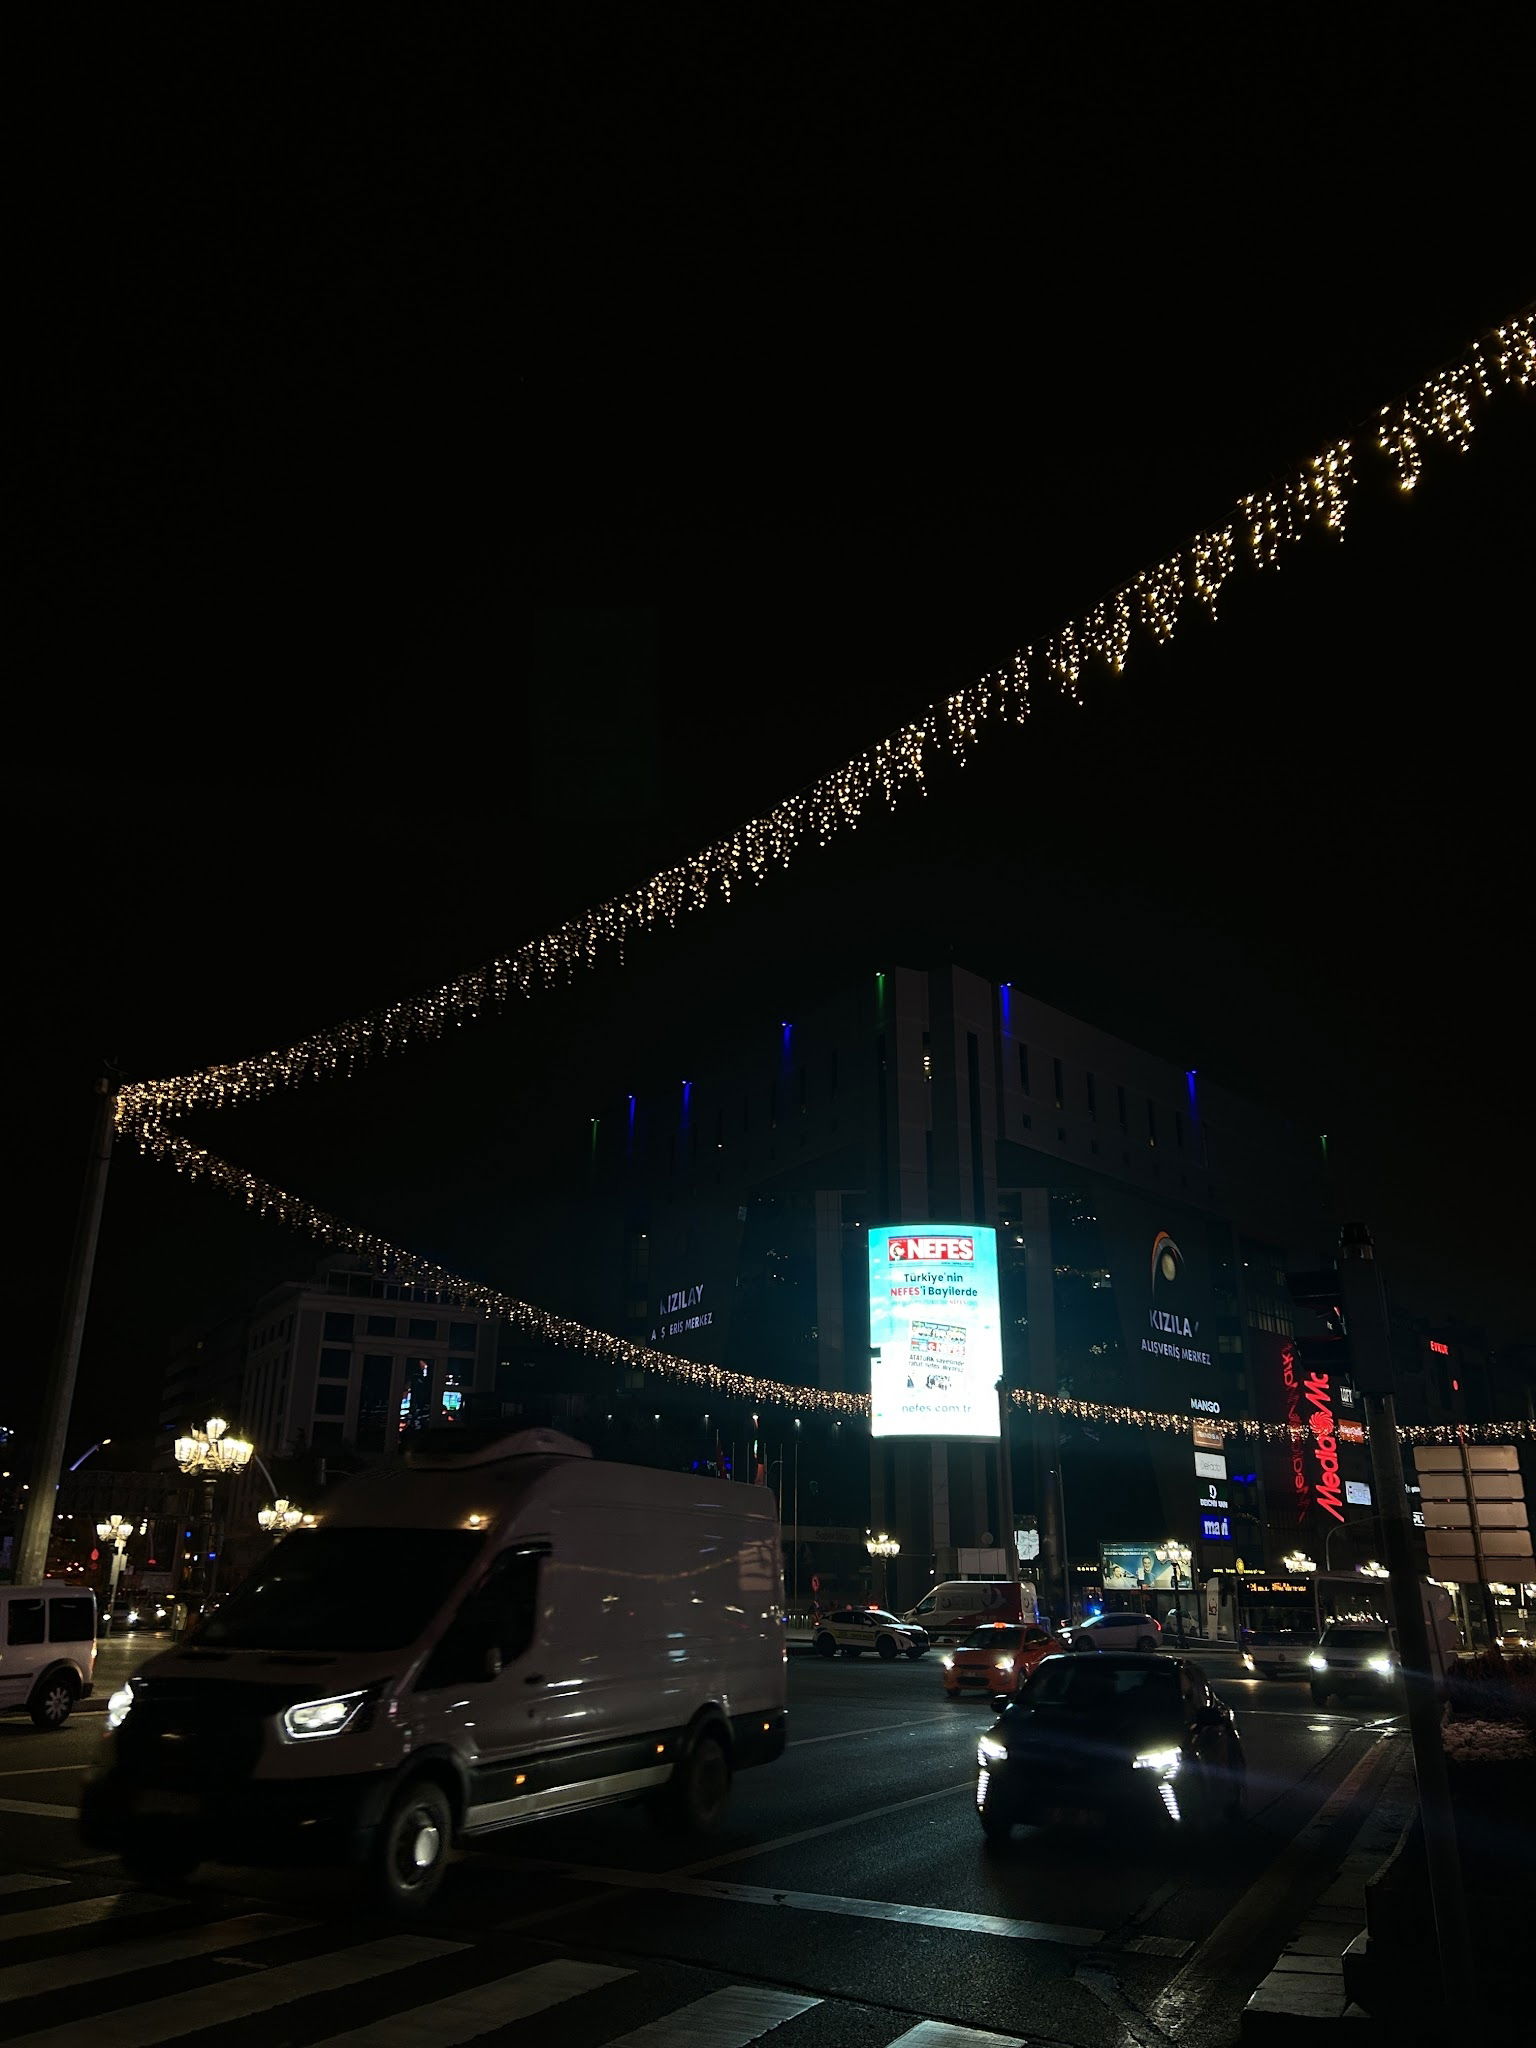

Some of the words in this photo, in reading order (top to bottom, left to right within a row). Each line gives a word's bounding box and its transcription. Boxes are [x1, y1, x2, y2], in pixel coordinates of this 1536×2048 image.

[907, 1239, 973, 1259] NEFES
[904, 1272, 963, 1284] Türkiye'nin
[928, 1286, 978, 1298] Bayilerde
[1190, 1398, 1220, 1413] MANGO
[1314, 1436, 1345, 1523] Media
